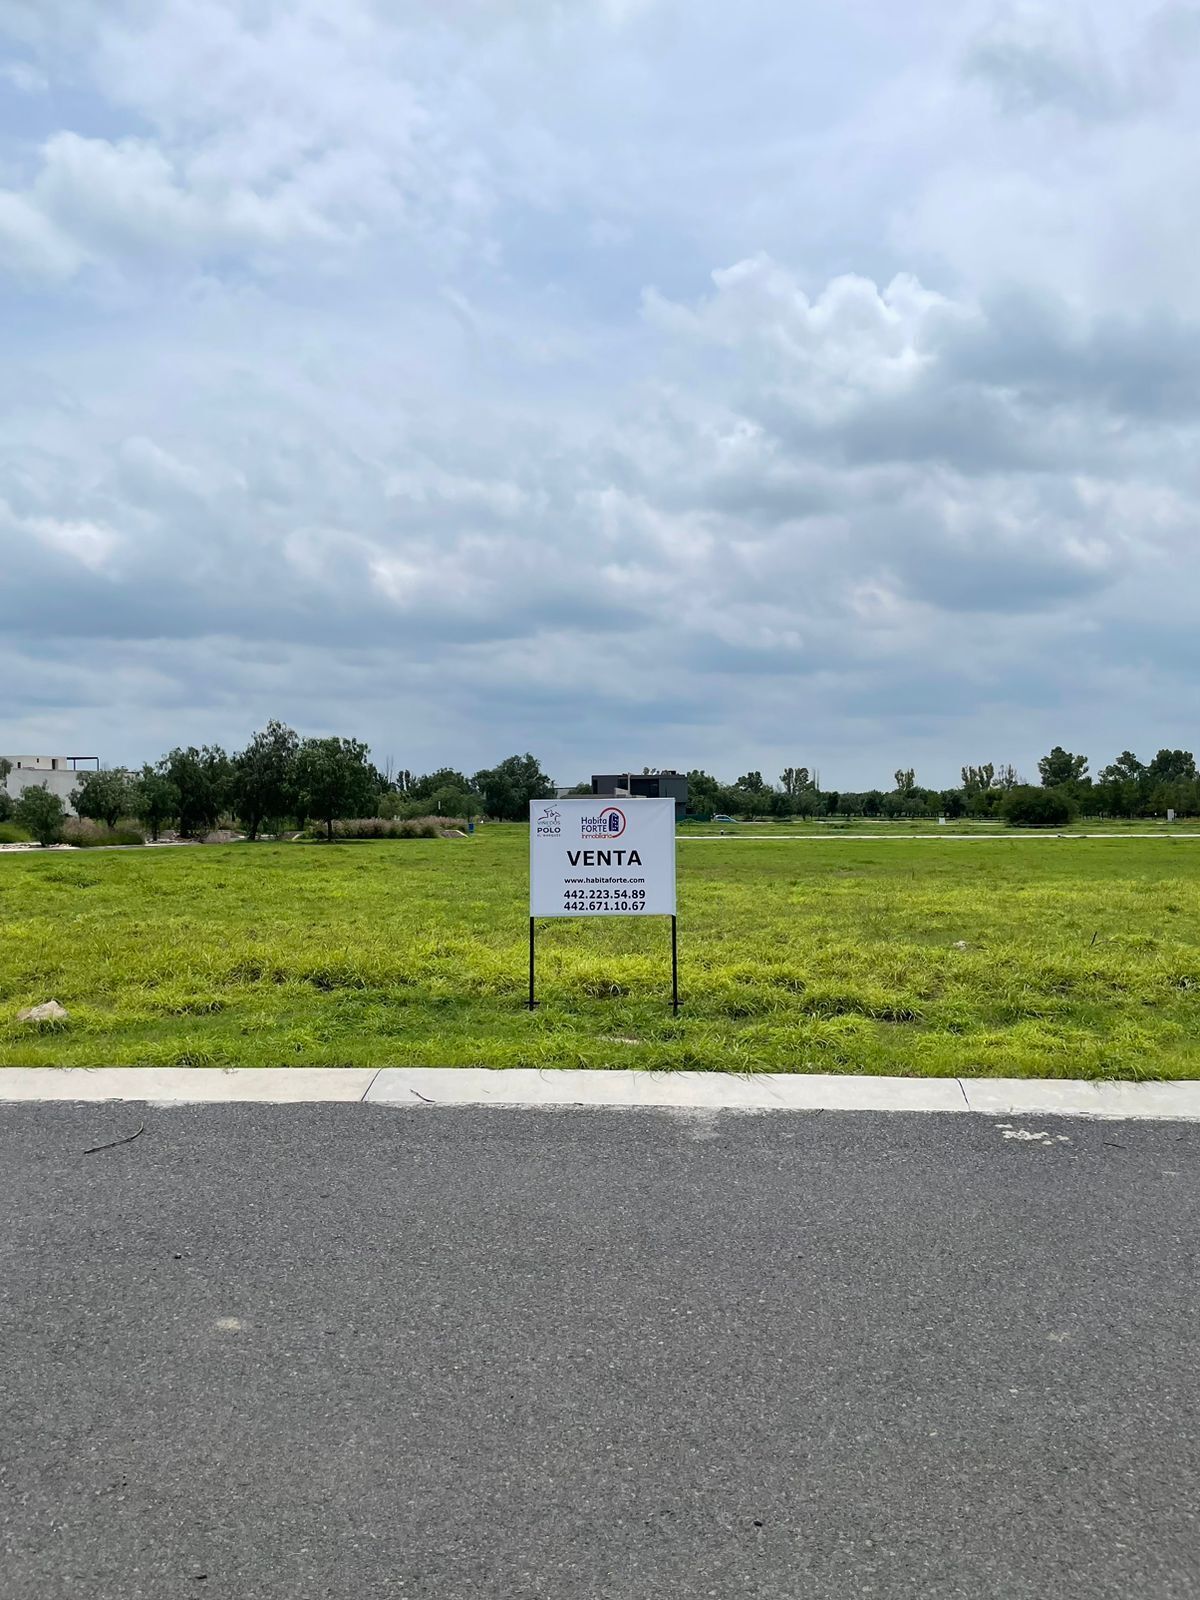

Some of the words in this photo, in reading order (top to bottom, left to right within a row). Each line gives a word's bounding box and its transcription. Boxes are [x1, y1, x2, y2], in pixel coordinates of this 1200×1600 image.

[581, 816, 607, 825] Habita
[581, 825, 607, 833] FORTE
[567, 850, 642, 866] VENTA
[564, 890, 646, 899] 442.223.54.89
[564, 901, 646, 911] 442.671.10.67
